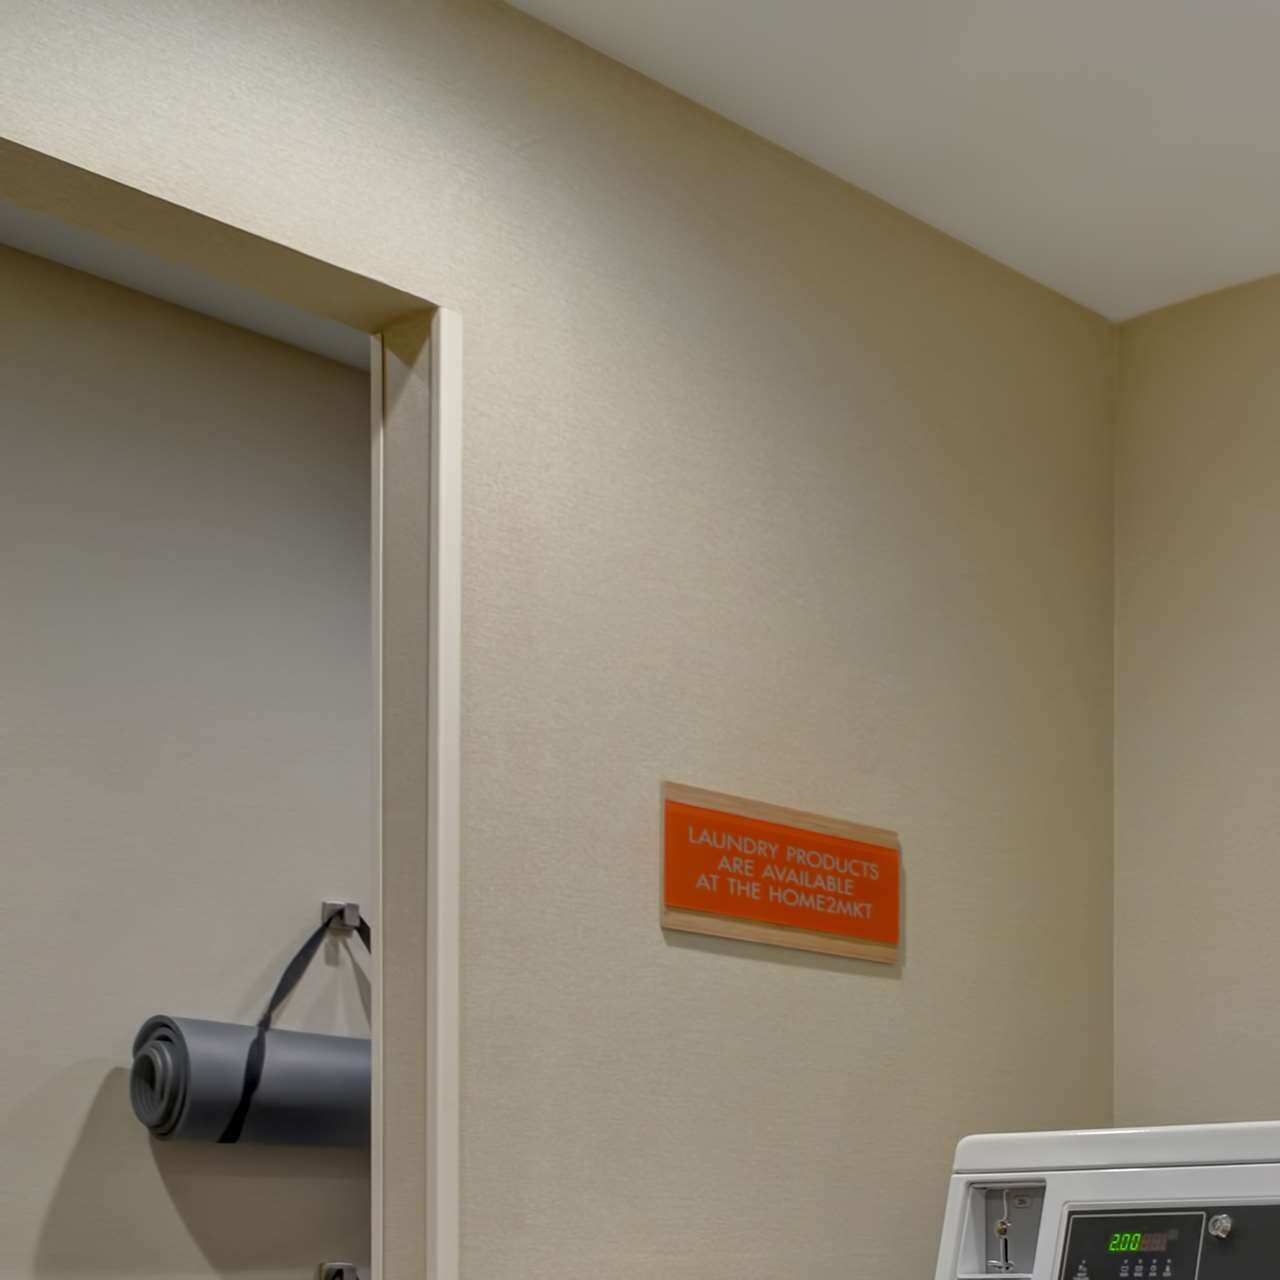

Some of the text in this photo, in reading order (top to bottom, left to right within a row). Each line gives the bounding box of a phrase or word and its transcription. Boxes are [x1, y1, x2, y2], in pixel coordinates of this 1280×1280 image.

[688, 826, 879, 881] LAUNDRY PRODUCTS
[696, 874, 872, 919] AT THE HOME2MKT
[718, 855, 854, 896] ARE AVAILABLE
[1109, 1233, 1141, 1251] 2.00
